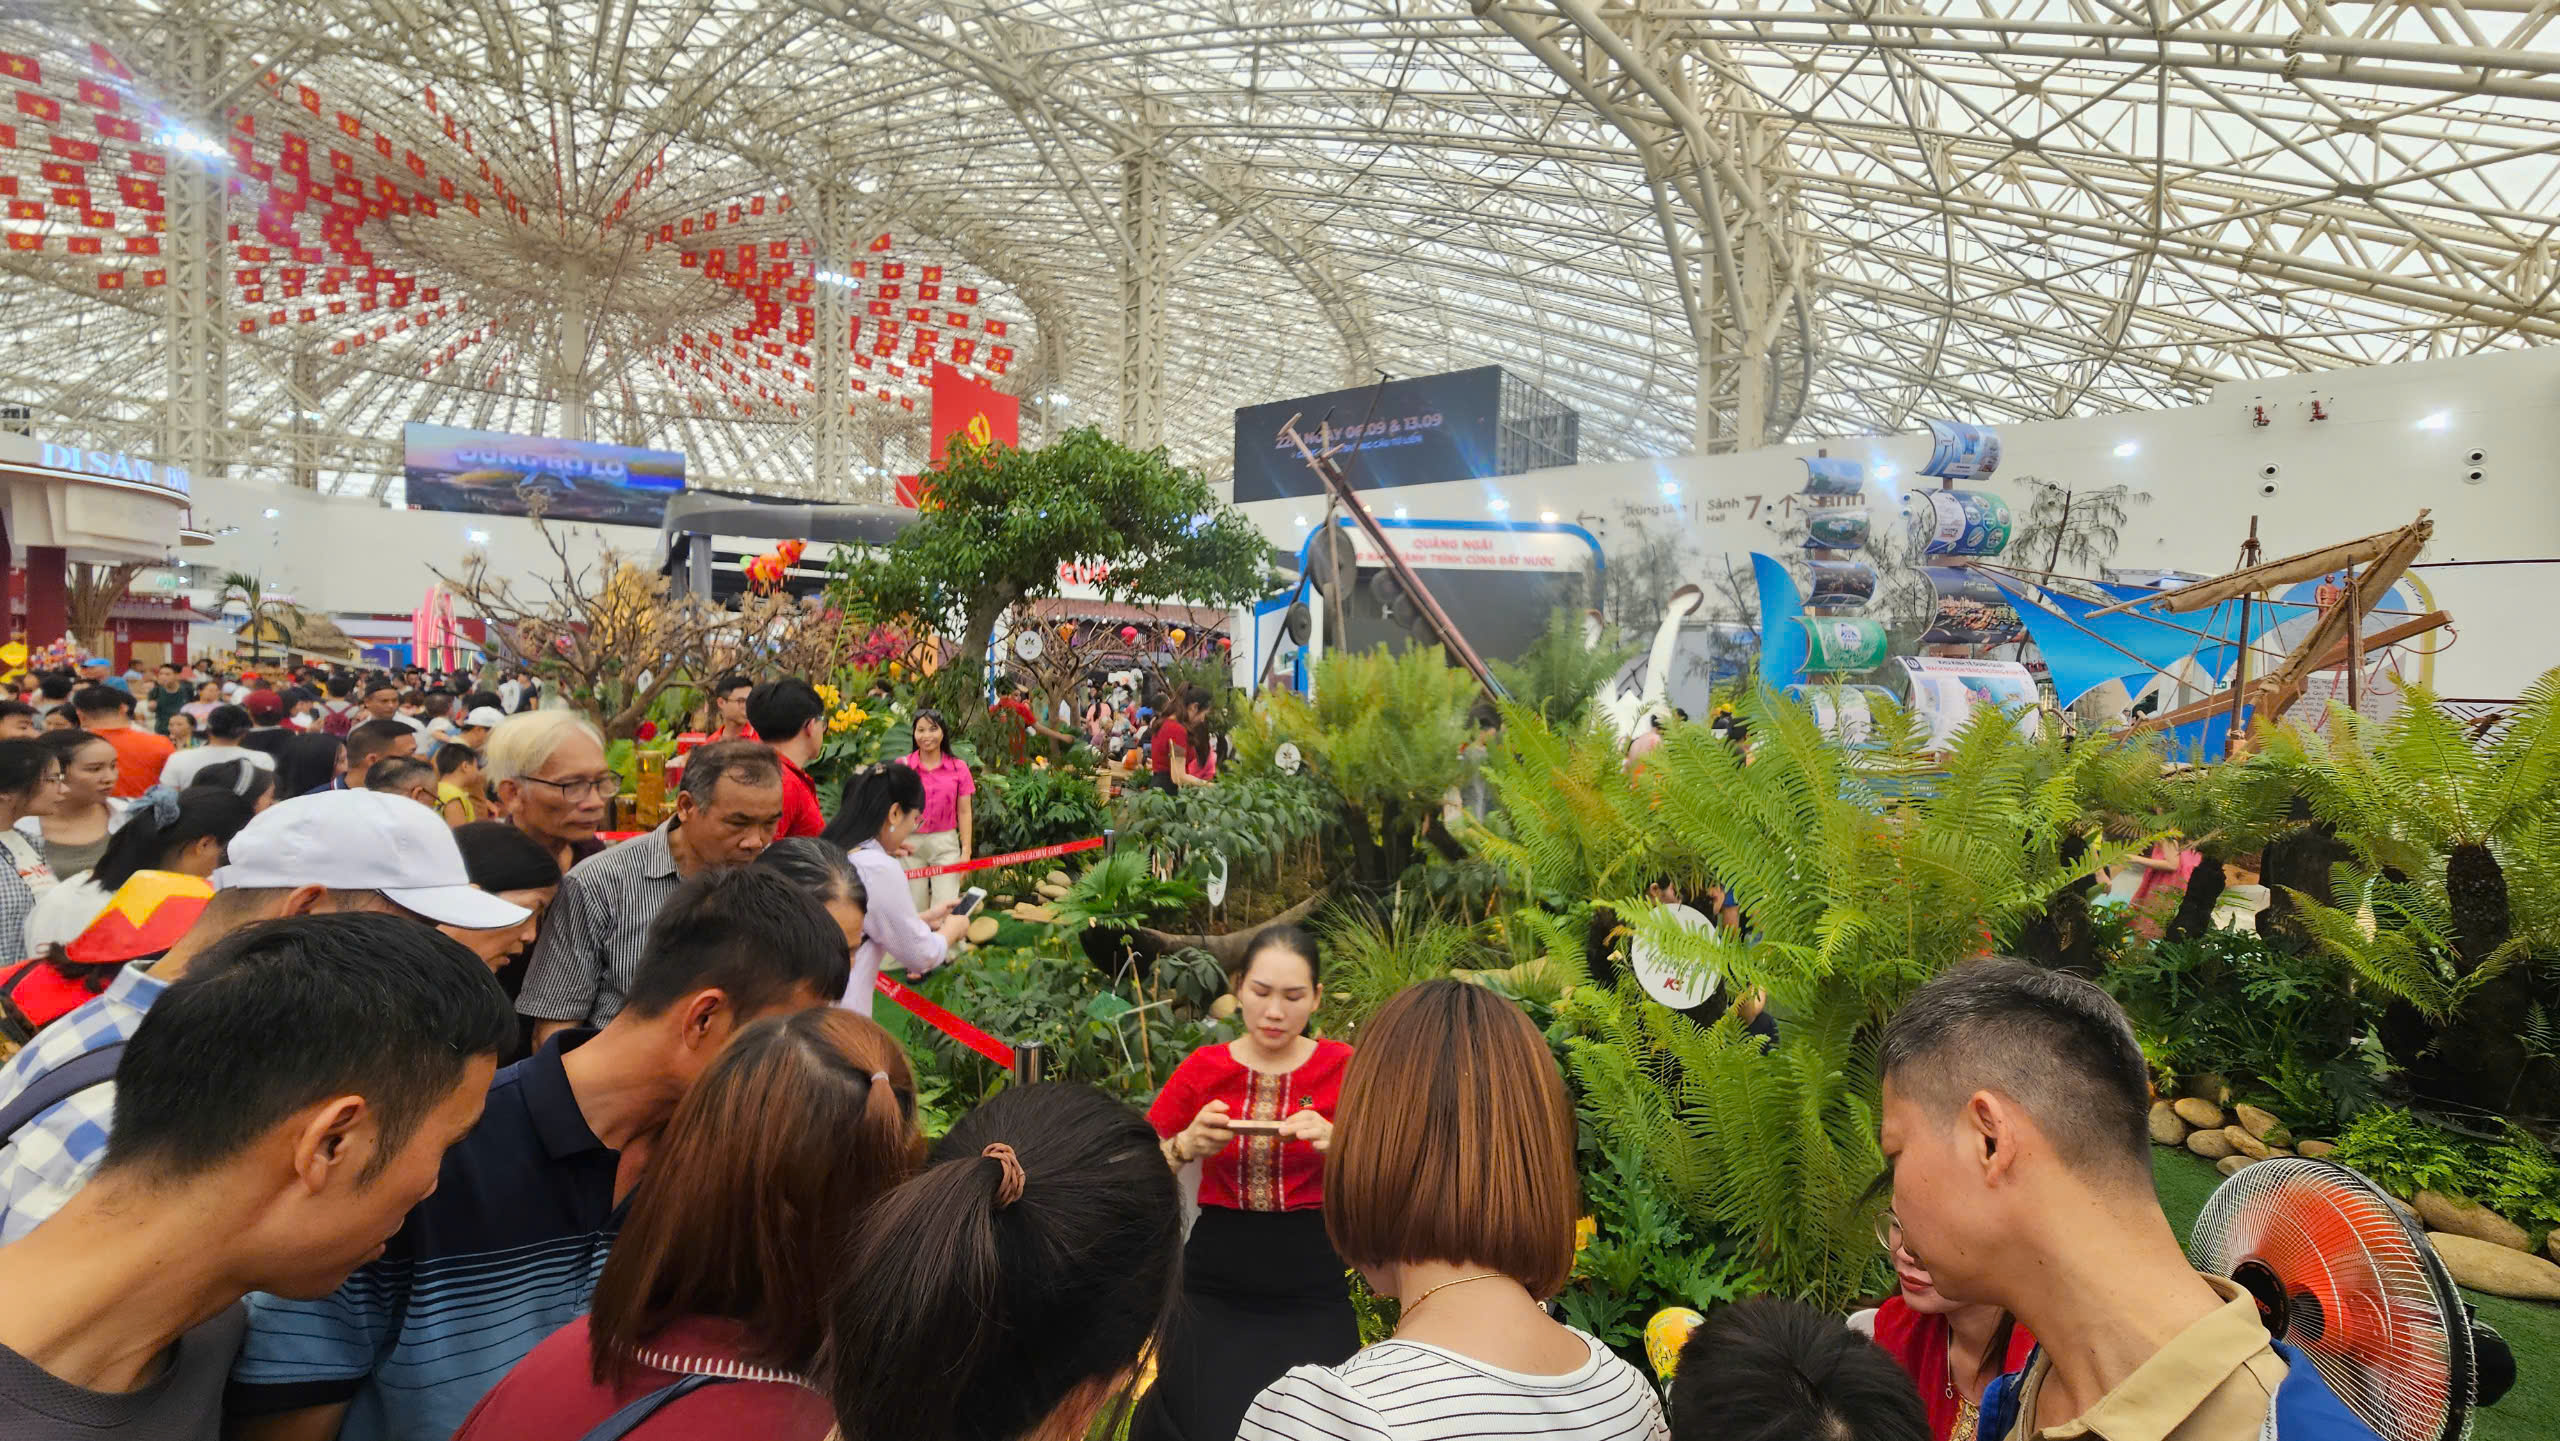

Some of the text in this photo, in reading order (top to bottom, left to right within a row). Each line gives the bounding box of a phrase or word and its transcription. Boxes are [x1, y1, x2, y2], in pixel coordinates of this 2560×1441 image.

[1404, 412, 1442, 430] 13.09
[1707, 495, 1762, 520] Sảnh 7
[1707, 513, 1725, 523] Hall
